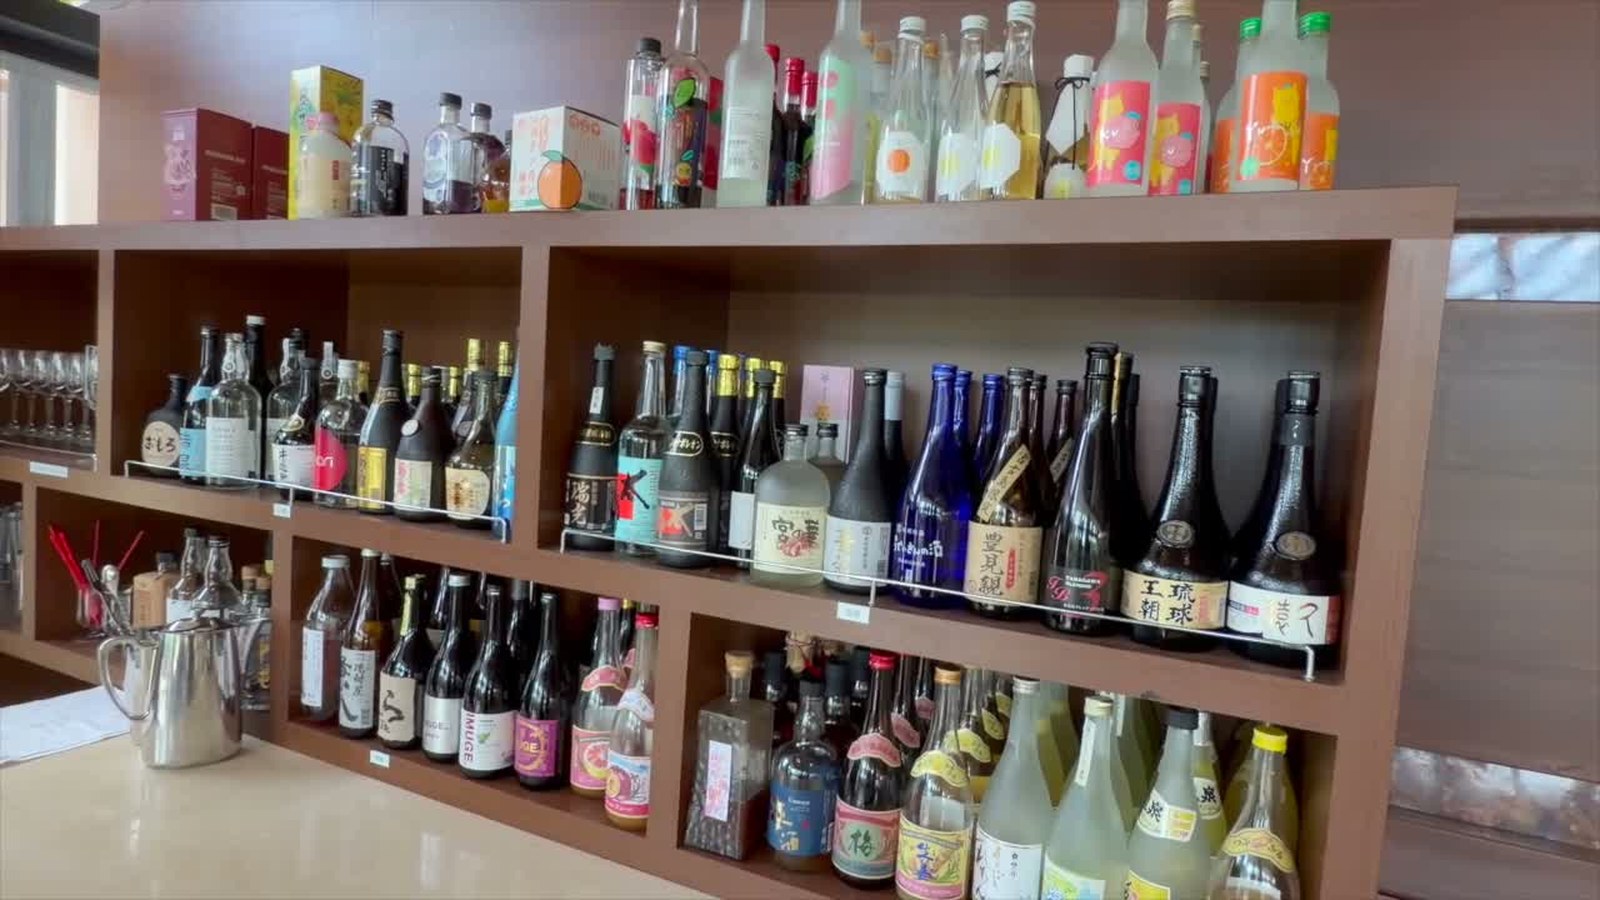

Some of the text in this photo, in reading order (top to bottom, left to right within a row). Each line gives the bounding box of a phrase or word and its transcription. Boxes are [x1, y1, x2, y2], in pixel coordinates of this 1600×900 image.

[1139, 580, 1164, 622] 王朝
[1166, 583, 1196, 625] 琉球
[463, 713, 476, 762] IMUGE
